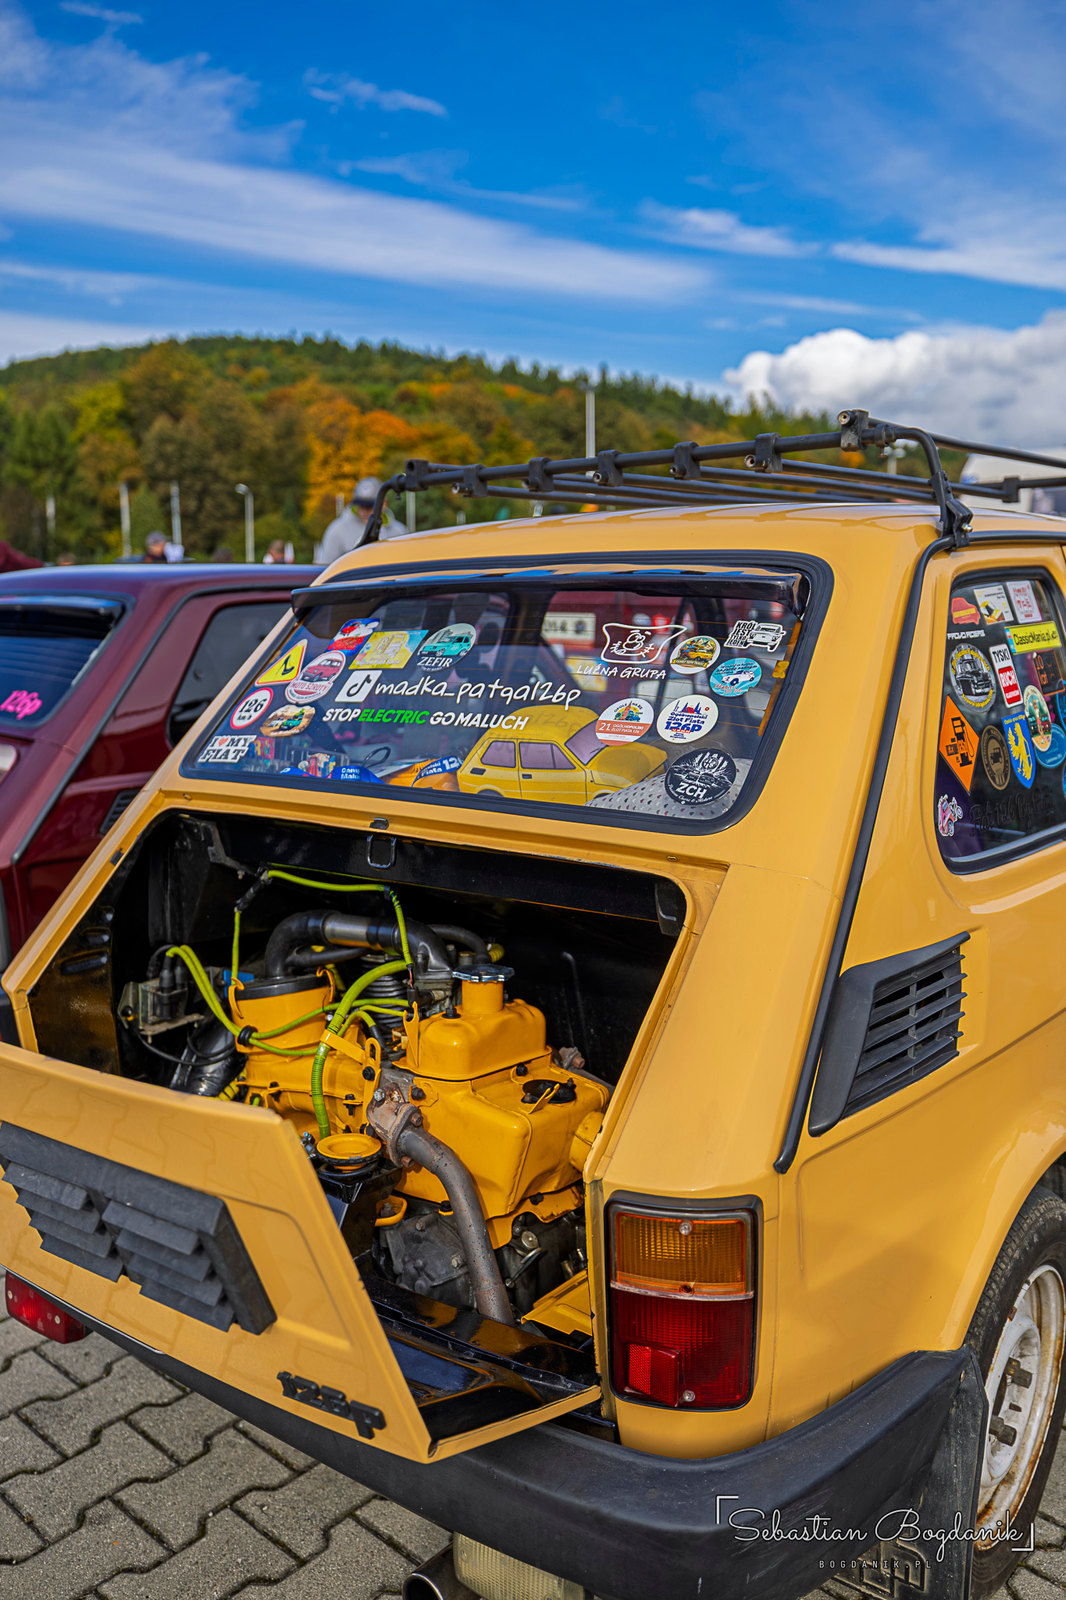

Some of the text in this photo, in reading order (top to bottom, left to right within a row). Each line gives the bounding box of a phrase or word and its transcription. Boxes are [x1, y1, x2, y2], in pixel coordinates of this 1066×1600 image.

[417, 656, 453, 667] ZEFIR
[619, 666, 667, 680] GRUPA
[239, 698, 267, 713] 126
[598, 722, 611, 732] 21
[200, 748, 245, 760] FIAT
[675, 782, 707, 799] ZCH
